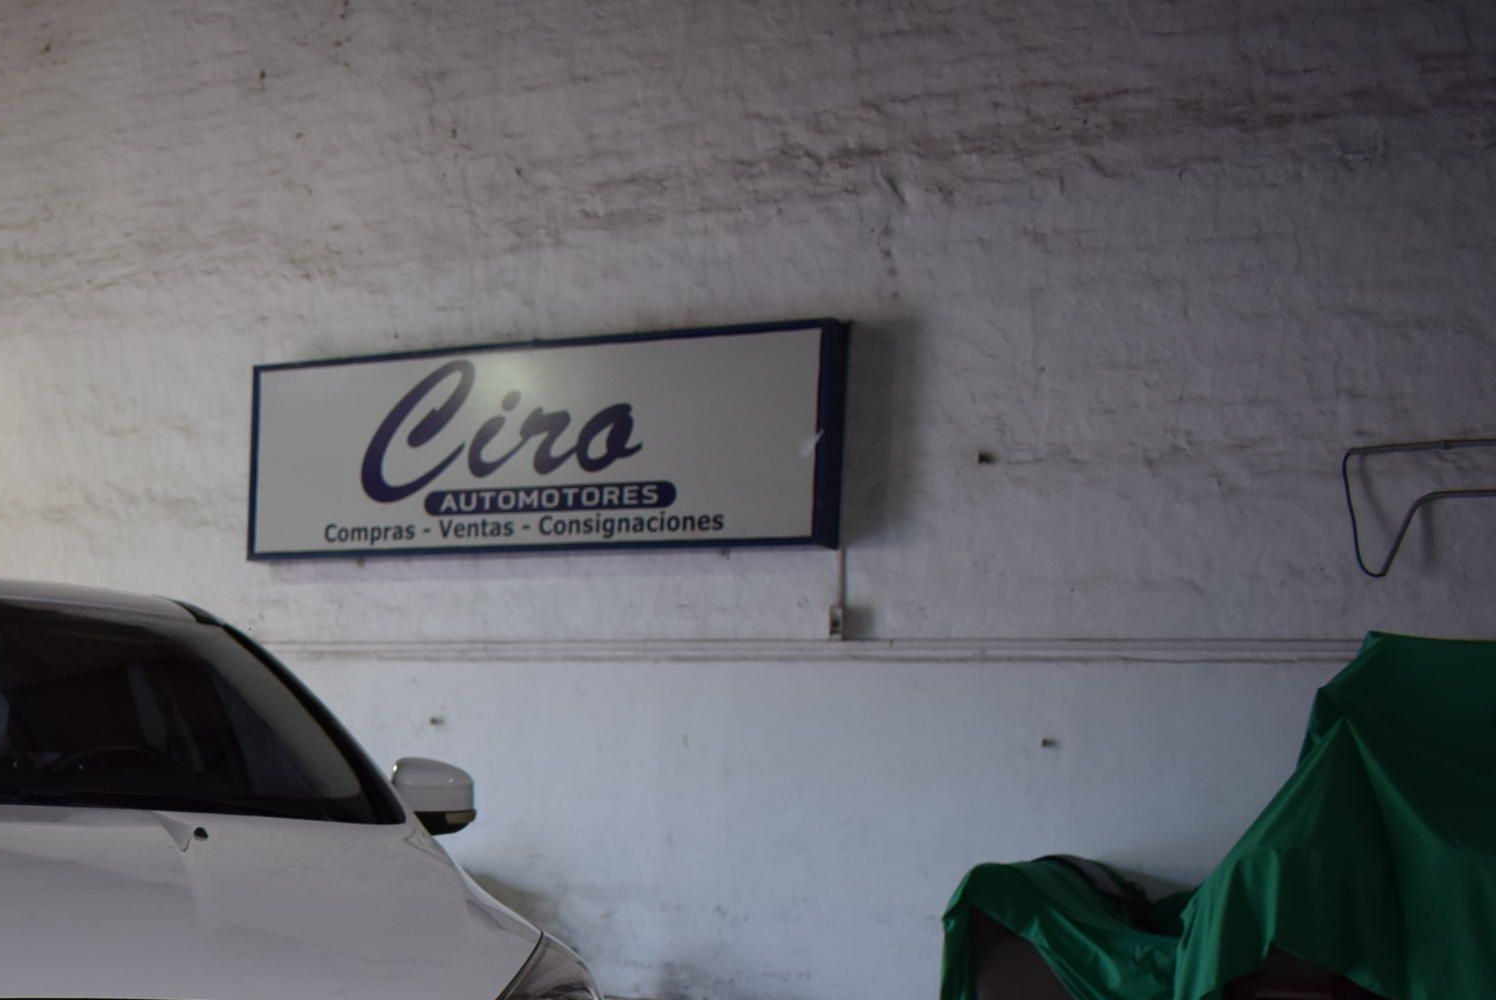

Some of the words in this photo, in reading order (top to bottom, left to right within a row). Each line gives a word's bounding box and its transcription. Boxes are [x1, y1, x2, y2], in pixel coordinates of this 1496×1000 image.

[360, 359, 643, 504] Ciro
[439, 484, 660, 514] AUTOMOTORES
[324, 520, 416, 546] Compras
[439, 517, 514, 539] Ventas
[538, 510, 725, 539] Consignaciones
